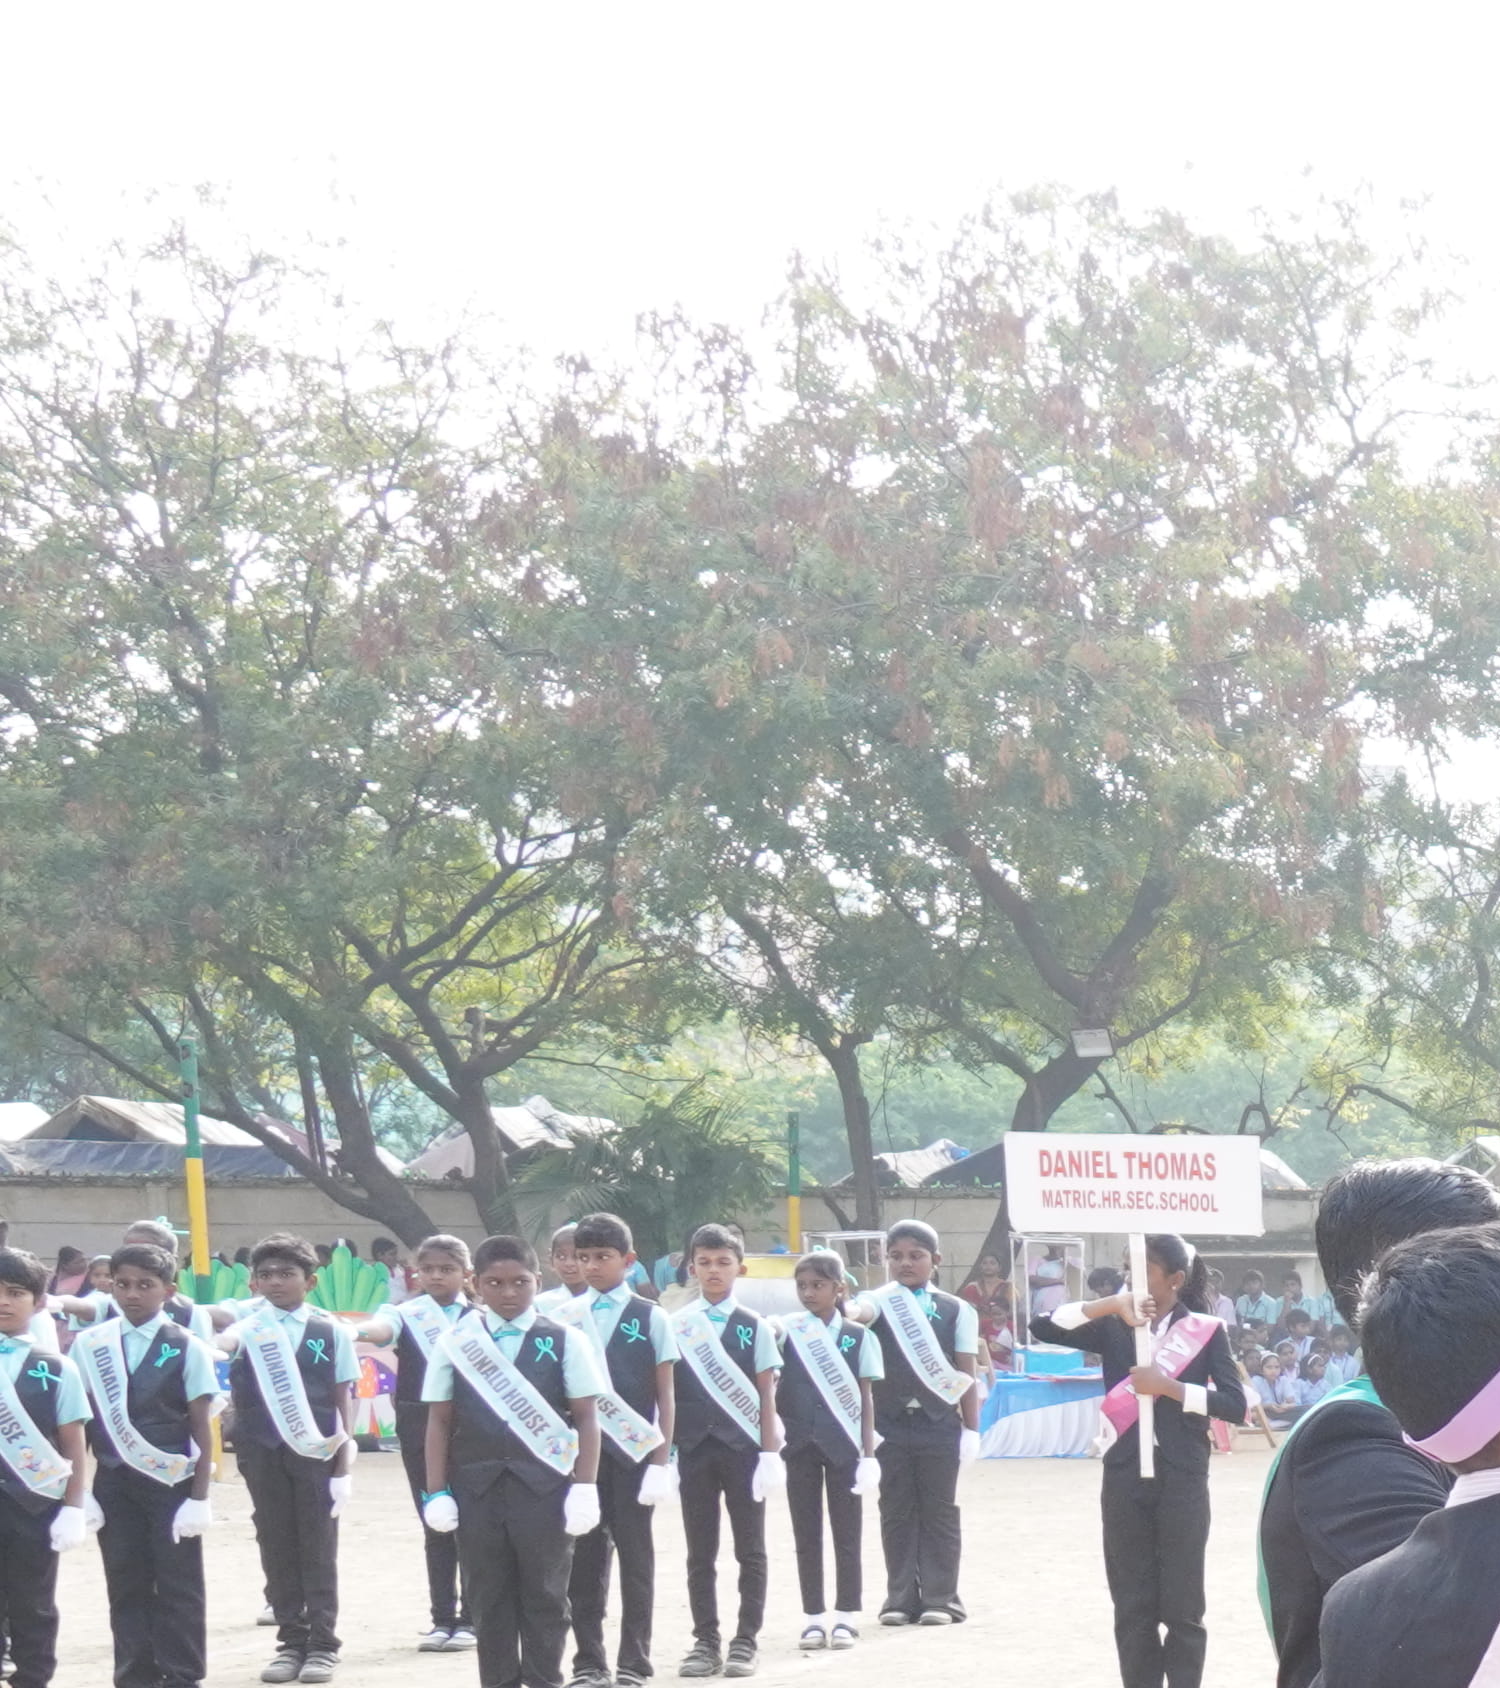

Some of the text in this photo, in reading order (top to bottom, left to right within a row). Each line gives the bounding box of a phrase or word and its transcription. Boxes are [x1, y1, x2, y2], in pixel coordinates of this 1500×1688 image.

[1038, 1149, 1217, 1181] DANIEL THOMAS
[1041, 1189, 1219, 1213] MATRIC.HR.SEC.SCHOOL
[694, 1341, 732, 1394] DONALD
[806, 1338, 842, 1387] DONALD
[888, 1295, 943, 1378] DONALD HOUSE
[92, 1346, 137, 1451] DONALD HOUSE
[259, 1341, 309, 1440] DONALD HOUSE
[460, 1339, 550, 1436] DONALD HOUSE
